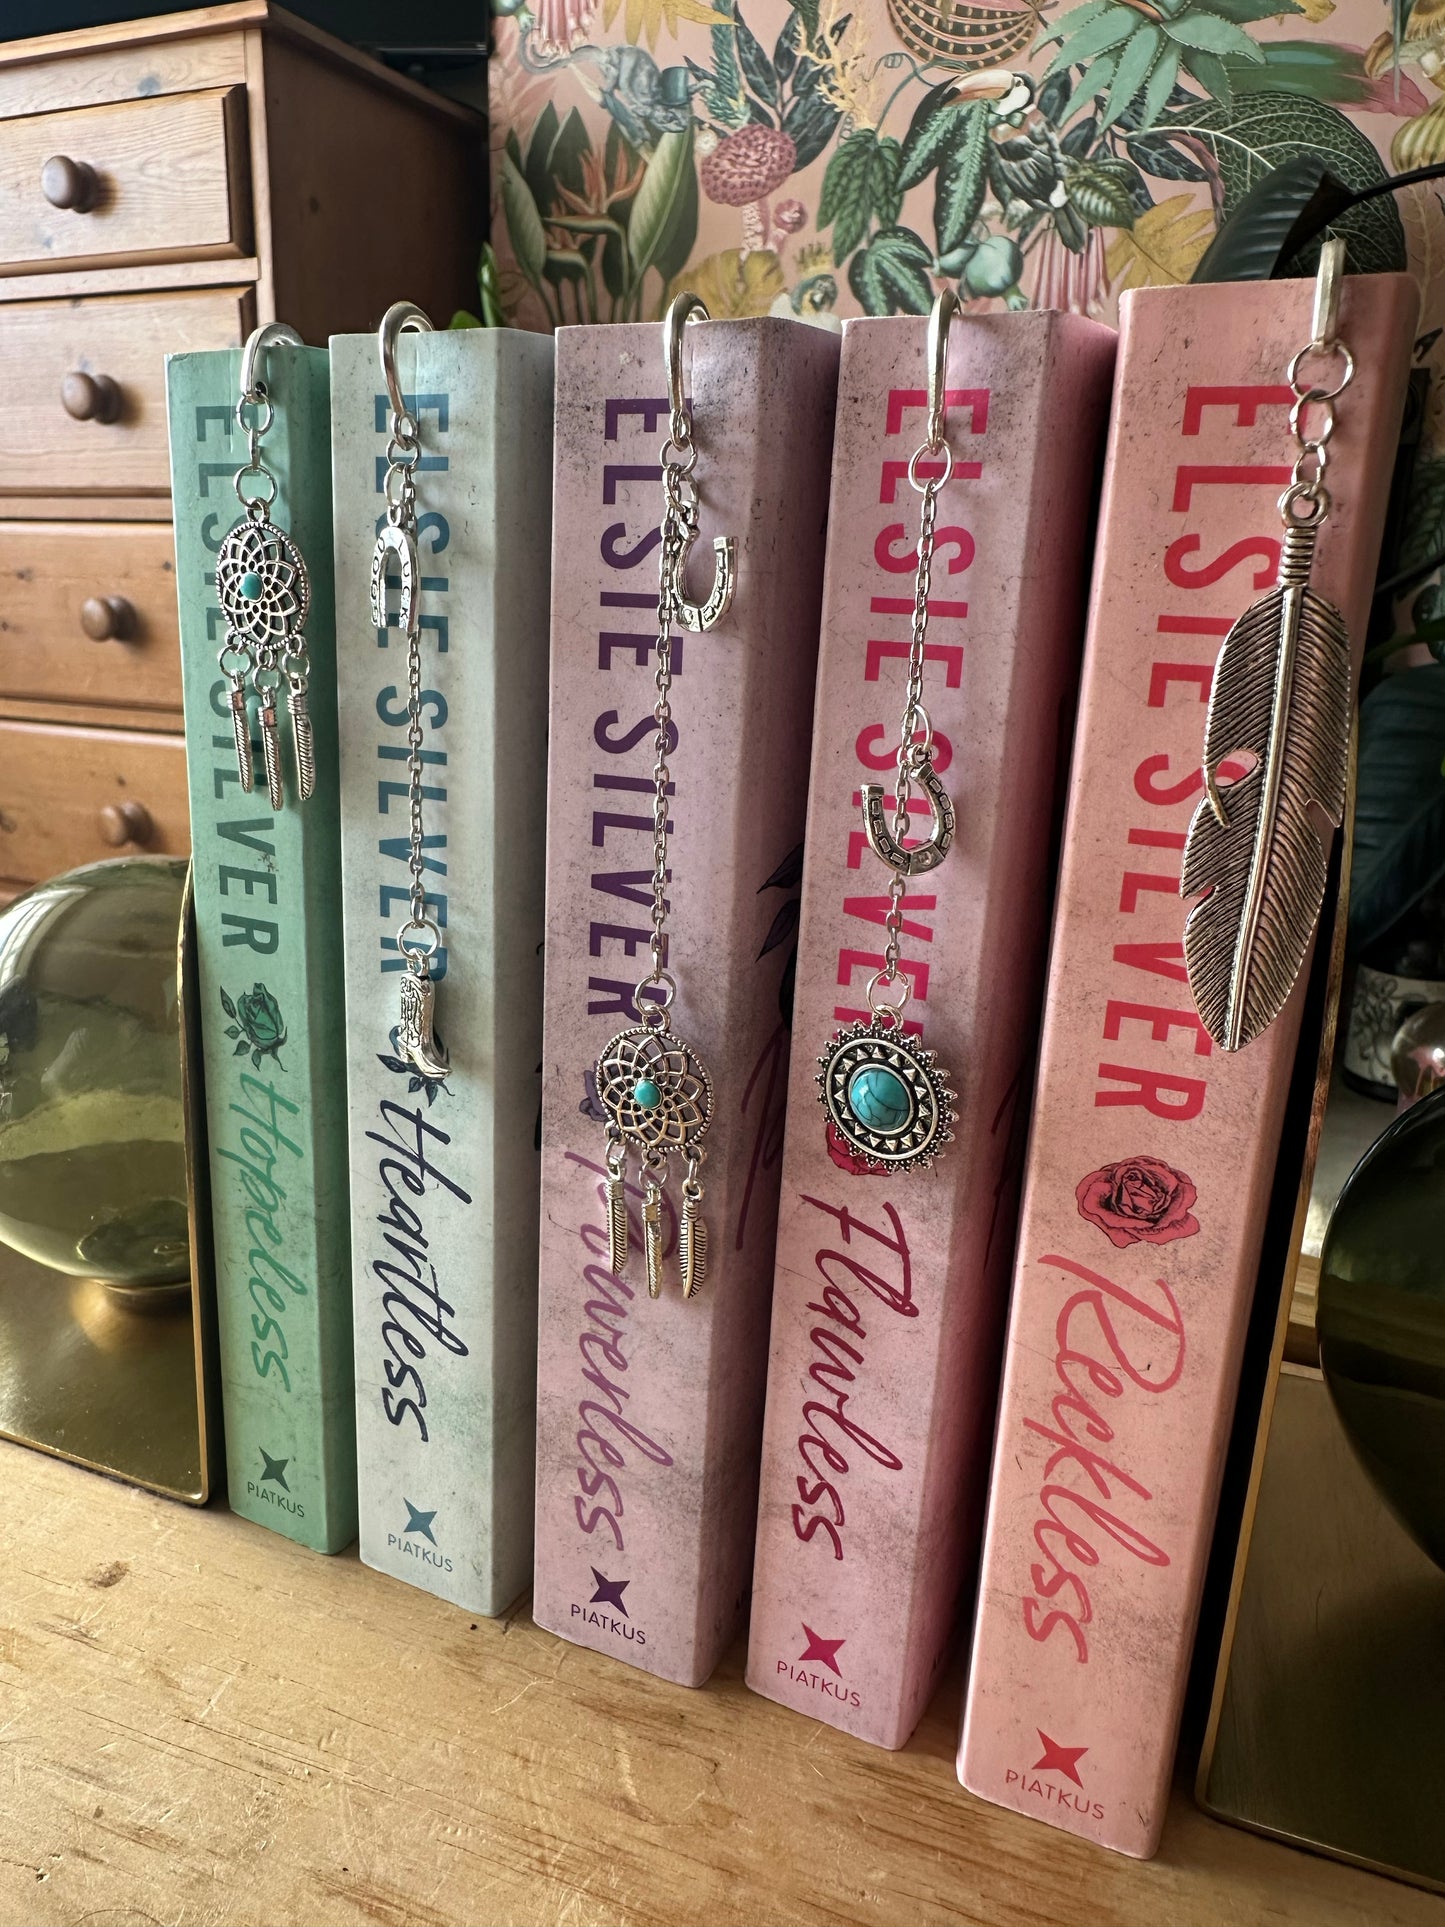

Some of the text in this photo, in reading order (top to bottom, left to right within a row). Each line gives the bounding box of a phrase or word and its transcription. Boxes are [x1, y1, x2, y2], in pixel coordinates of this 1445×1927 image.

[375, 394, 449, 981] ELSIE SILVER
[864, 389, 990, 688] ELSIE
[209, 679, 279, 954] SILVER
[588, 398, 692, 1025] ELSIE SILVER
[216, 1073, 308, 1392] Hopeless
[364, 1100, 472, 1443] Heartless
[792, 1194, 920, 1562] Flawless
[247, 1480, 305, 1518] PIATKUS
[387, 1532, 453, 1574] PIATKUS
[1022, 1253, 1185, 1665] Reckless
[570, 1603, 646, 1646] PIATKUS
[777, 1659, 861, 1709] PIATKUS
[1005, 1768, 1105, 1821] PIATKUS
